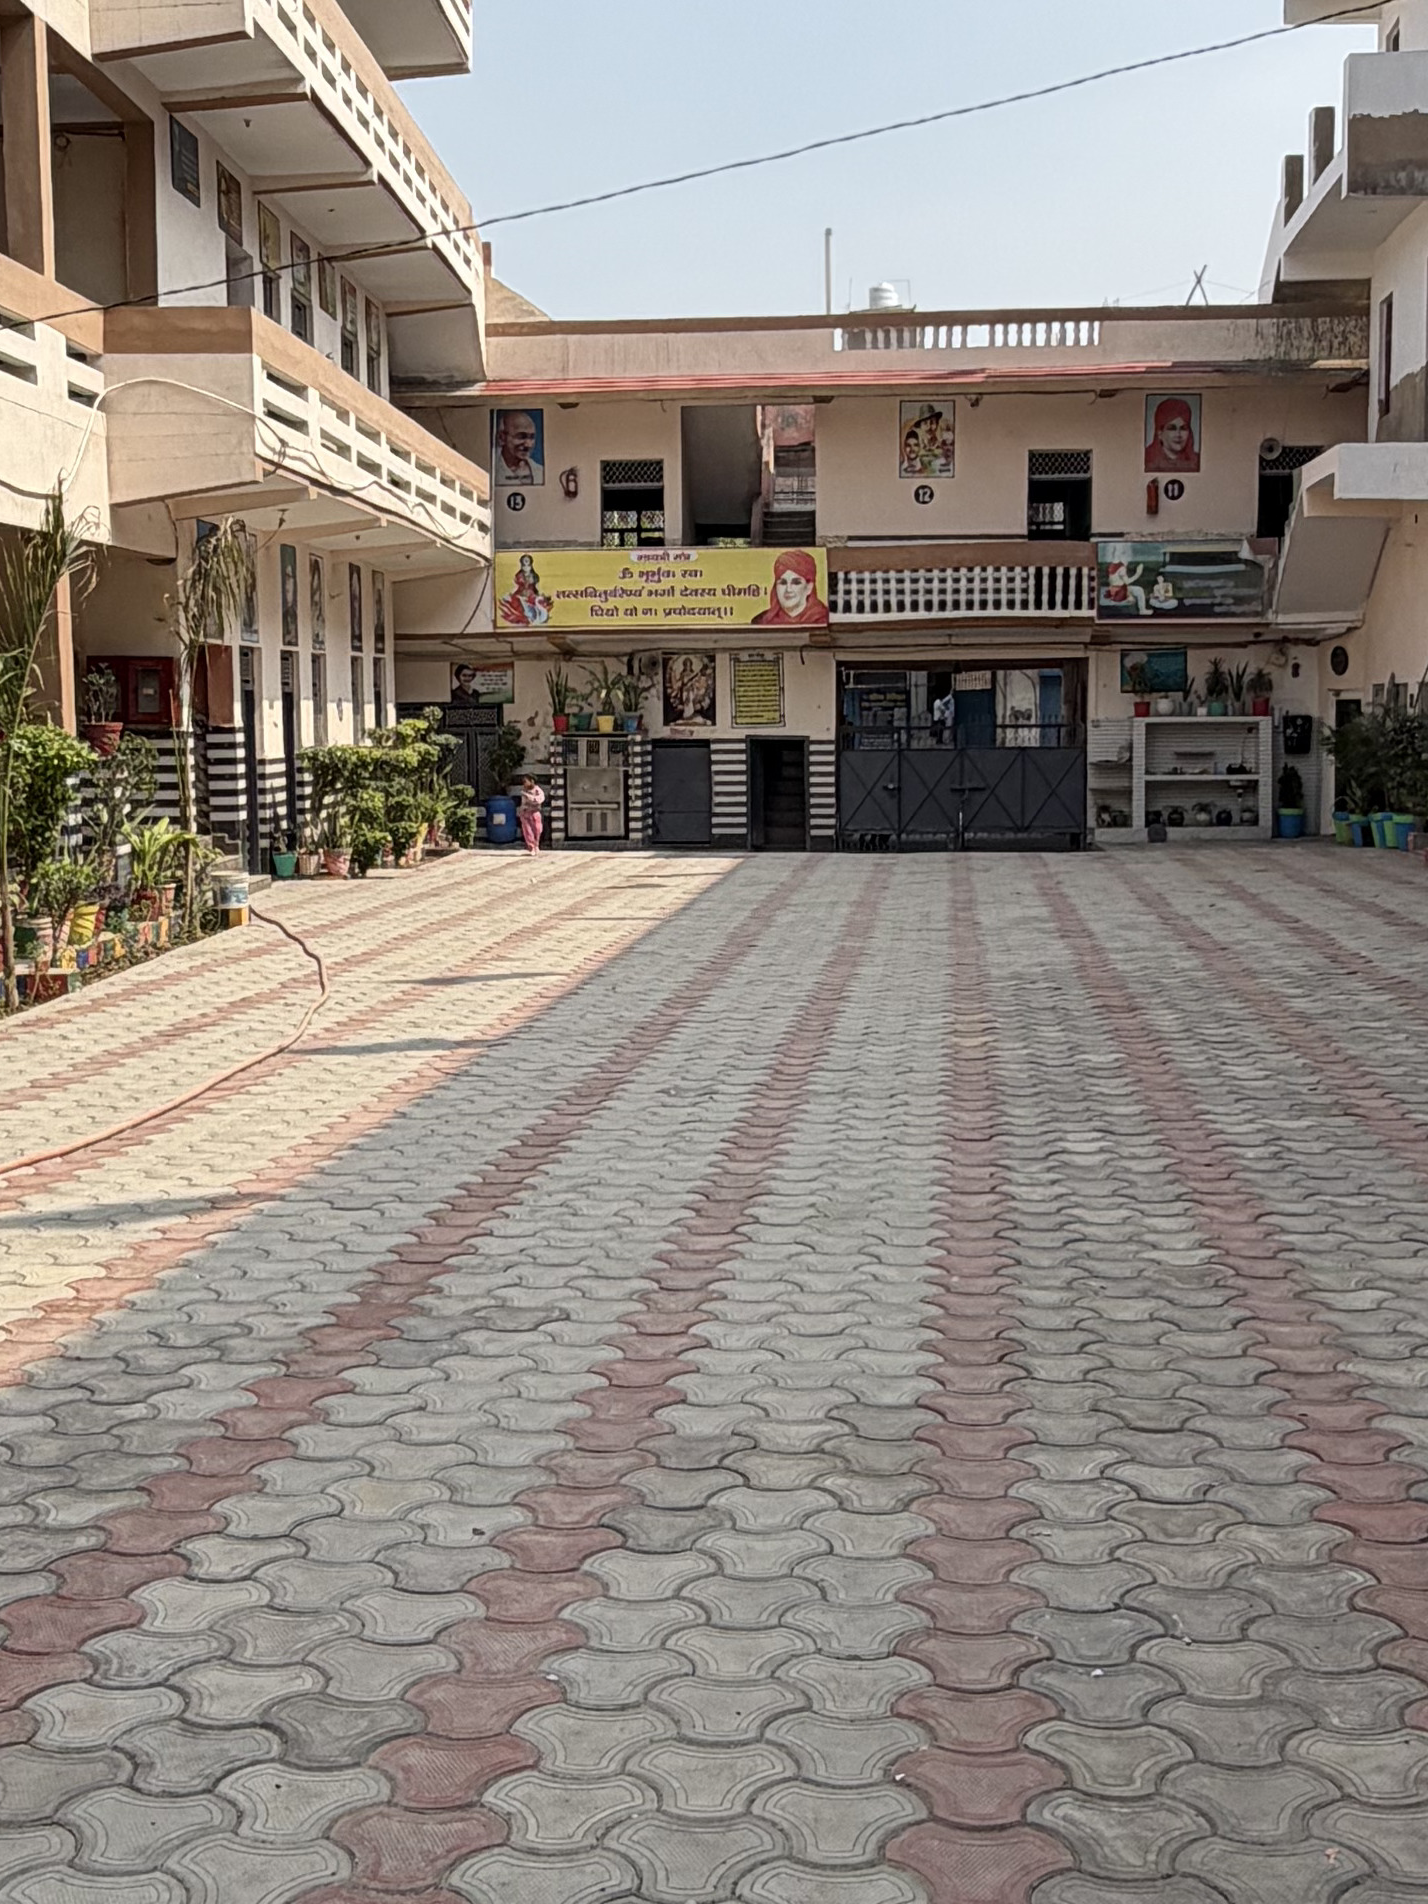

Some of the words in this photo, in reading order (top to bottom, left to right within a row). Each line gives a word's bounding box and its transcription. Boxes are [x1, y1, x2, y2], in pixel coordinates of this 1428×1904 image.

[918, 488, 931, 502] 12
[1167, 483, 1179, 497] 11
[509, 495, 524, 509] 13
[619, 567, 634, 580] ॐ
